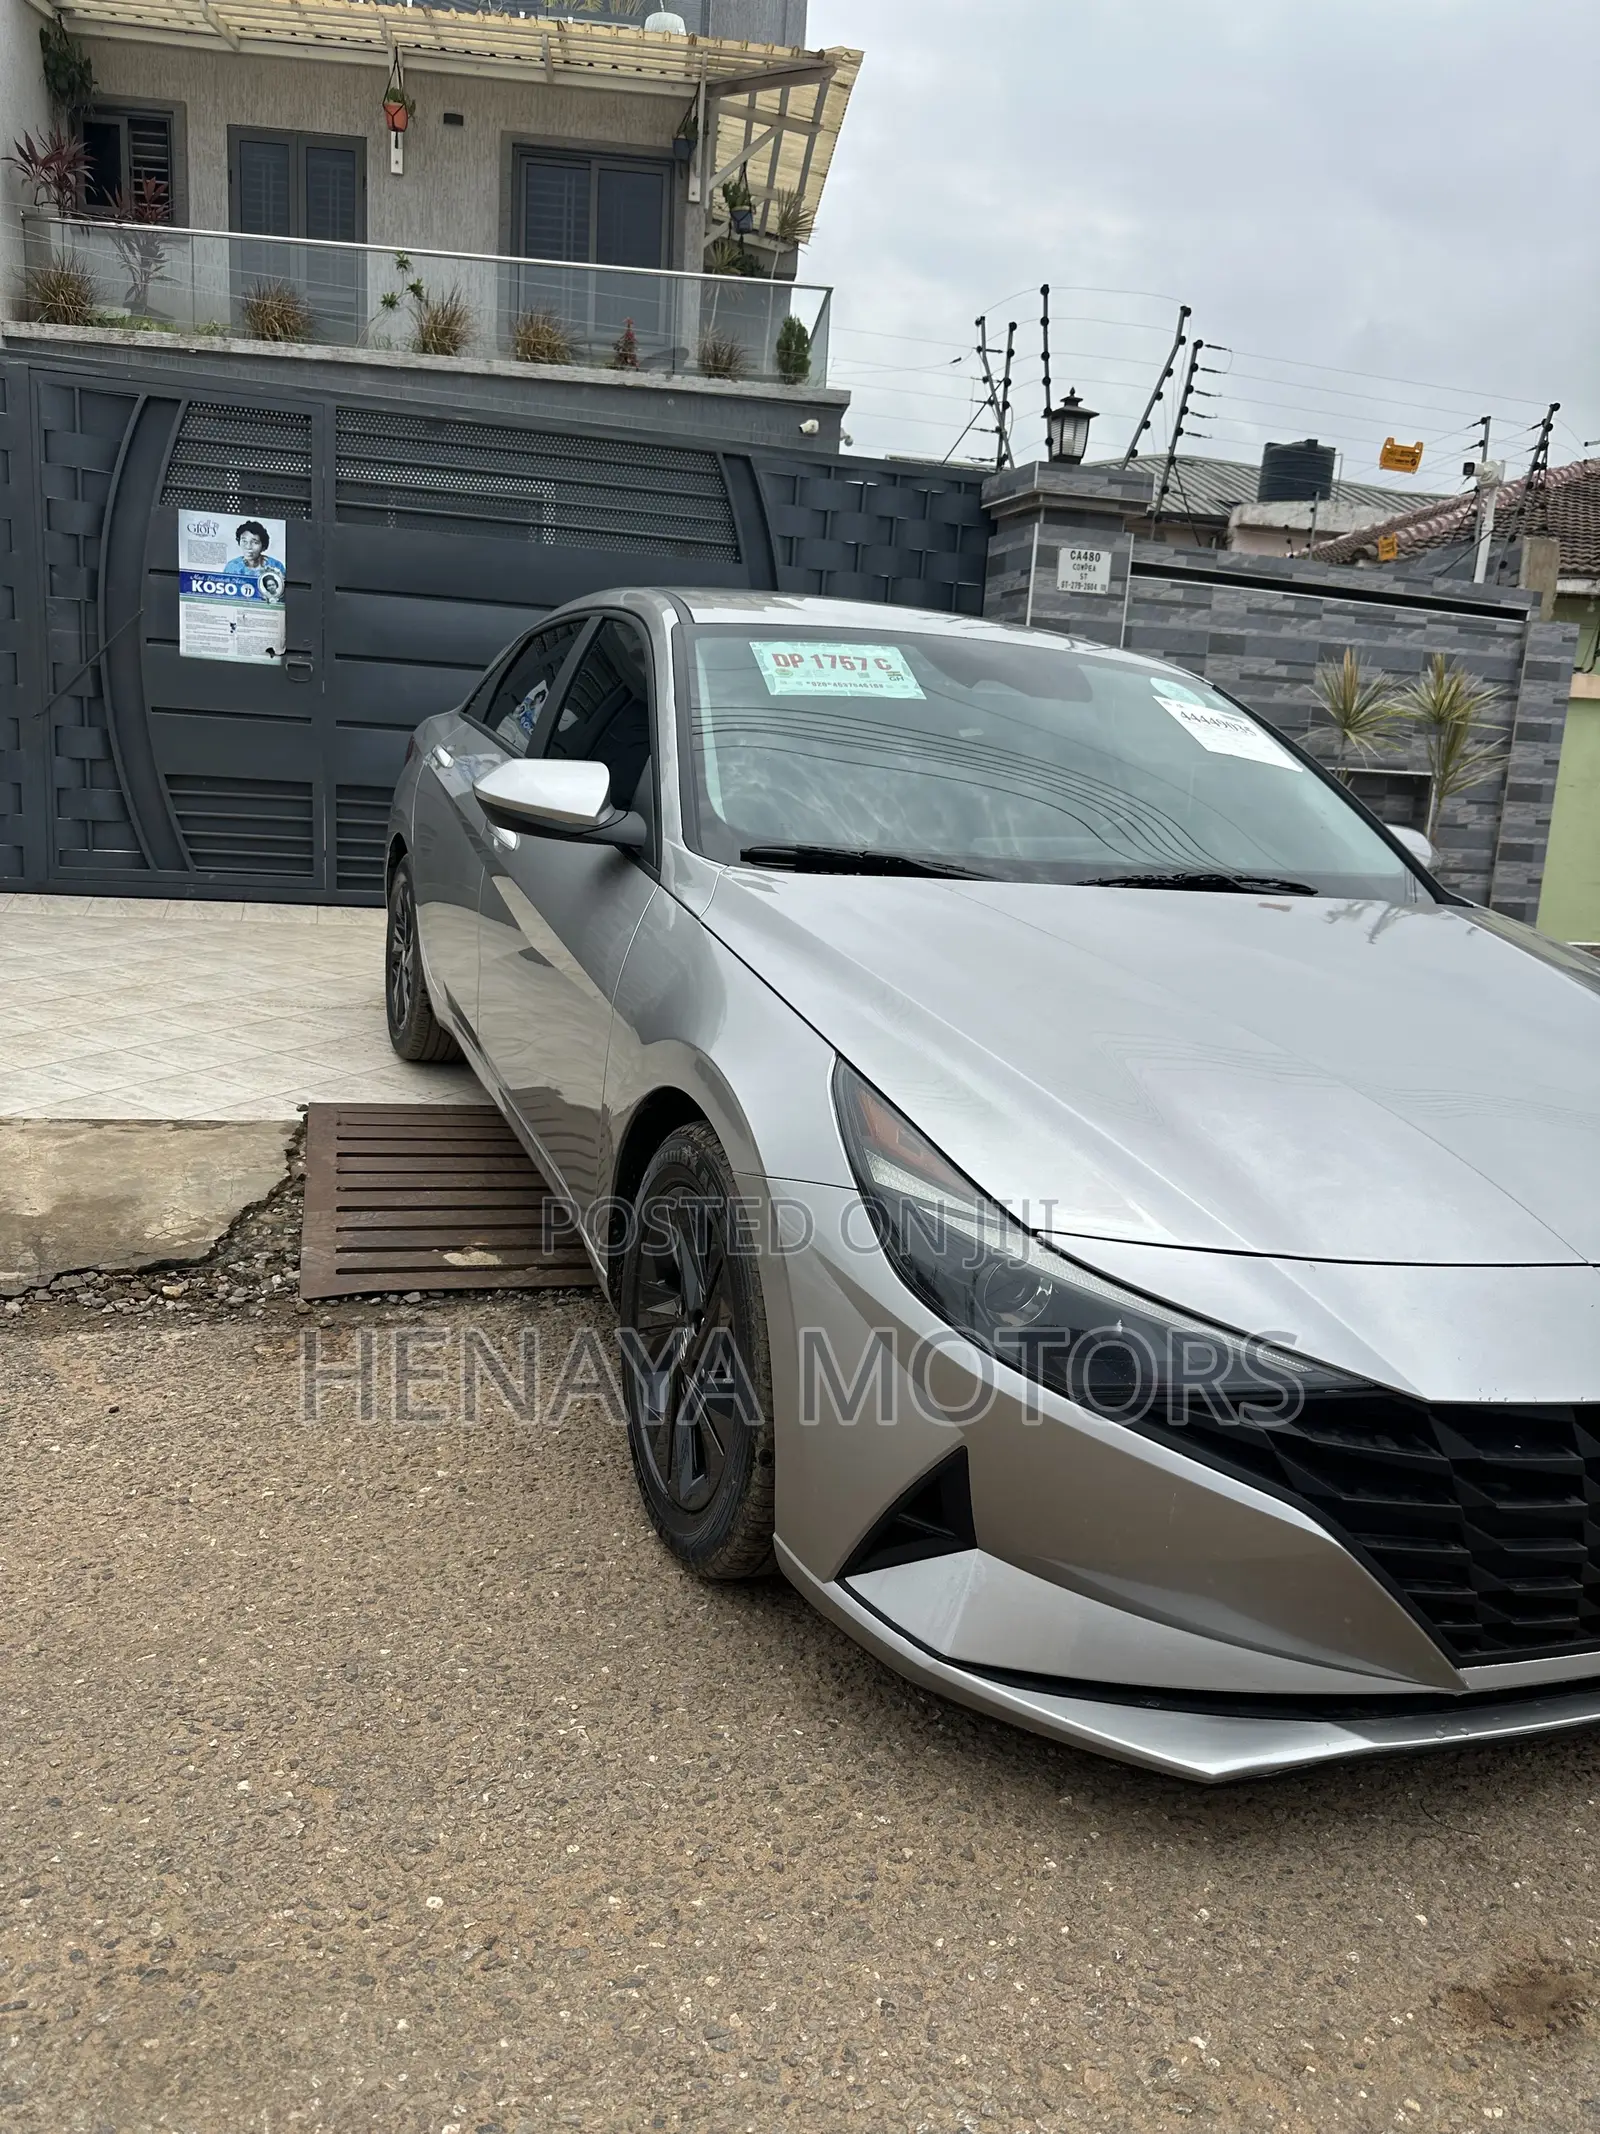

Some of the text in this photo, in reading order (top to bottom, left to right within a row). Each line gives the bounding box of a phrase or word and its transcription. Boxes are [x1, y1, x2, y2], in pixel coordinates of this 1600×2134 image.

[1070, 550, 1101, 562] CA480
[191, 579, 238, 596] KOSO
[772, 653, 892, 671] DP 1757 C
